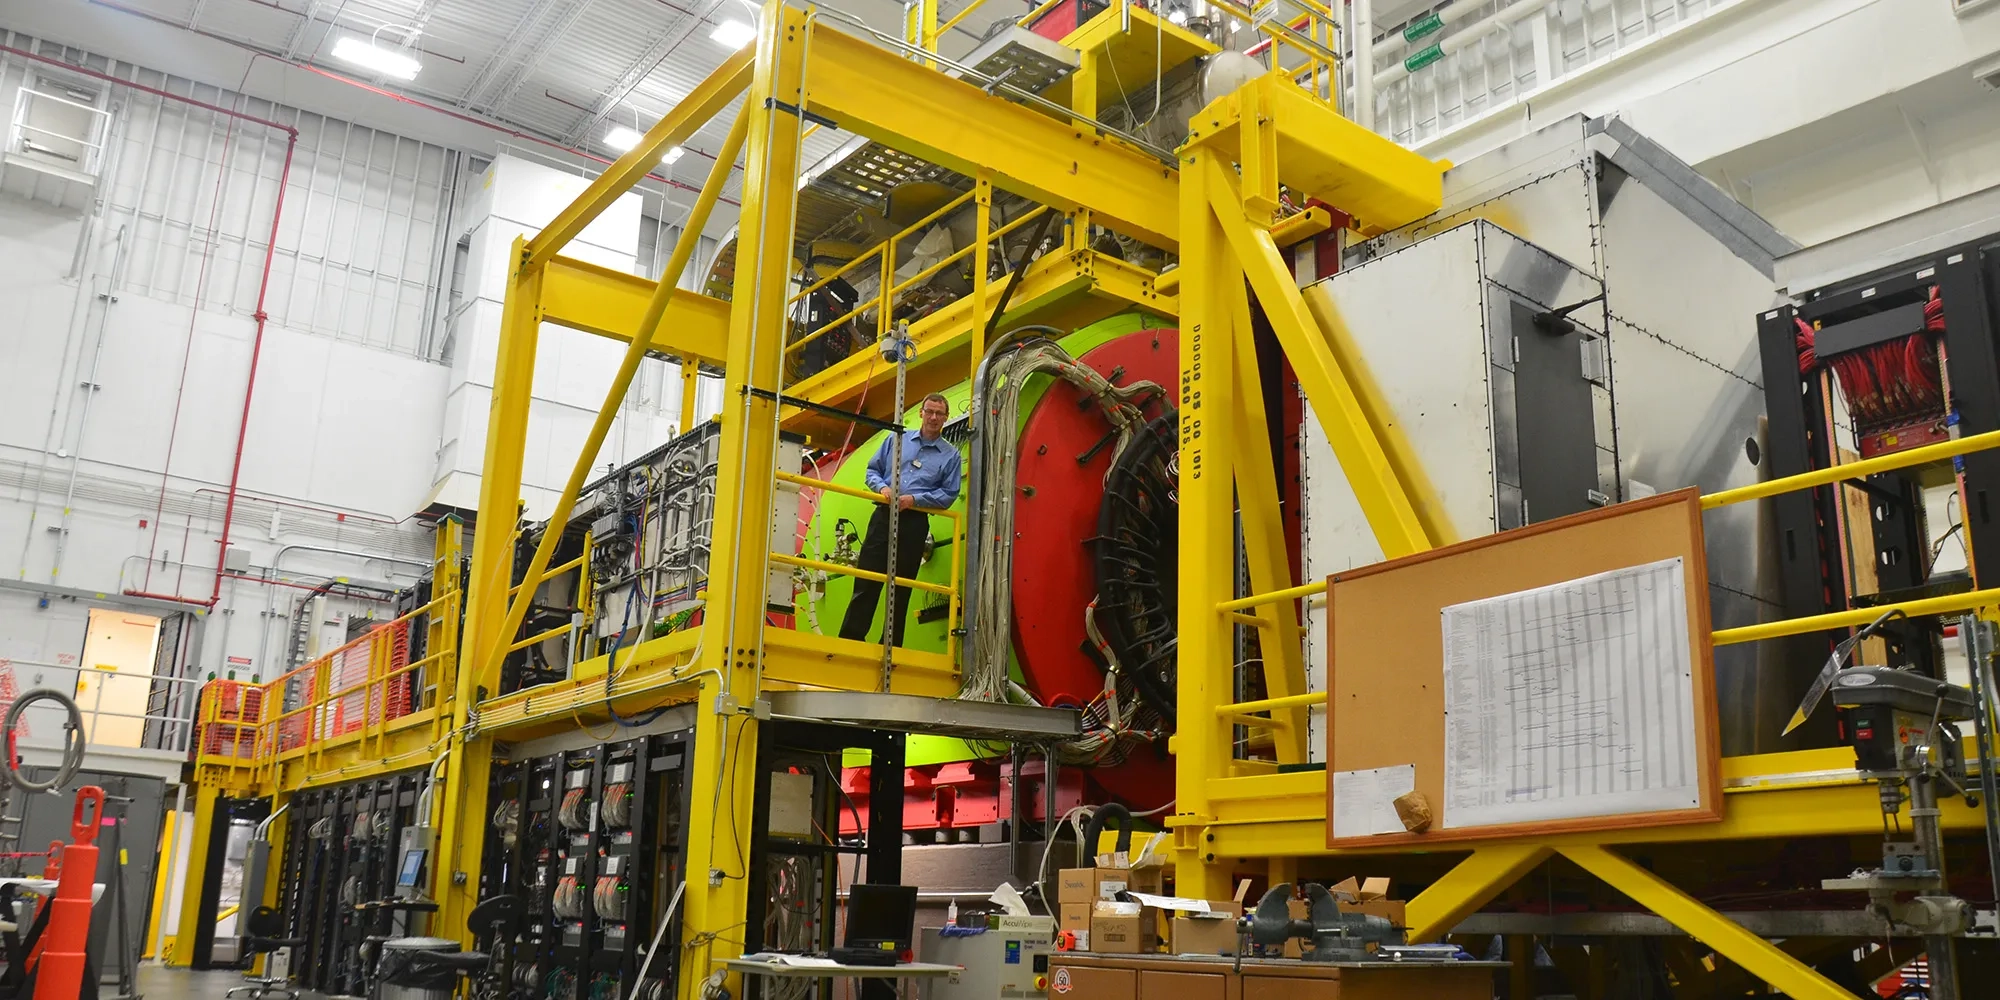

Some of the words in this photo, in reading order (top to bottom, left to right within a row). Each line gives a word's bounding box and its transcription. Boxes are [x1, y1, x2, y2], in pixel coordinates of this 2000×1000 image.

[1182, 415, 1191, 451] LBS.
[1192, 419, 1201, 440] 00
[1058, 976, 1067, 985] 50
